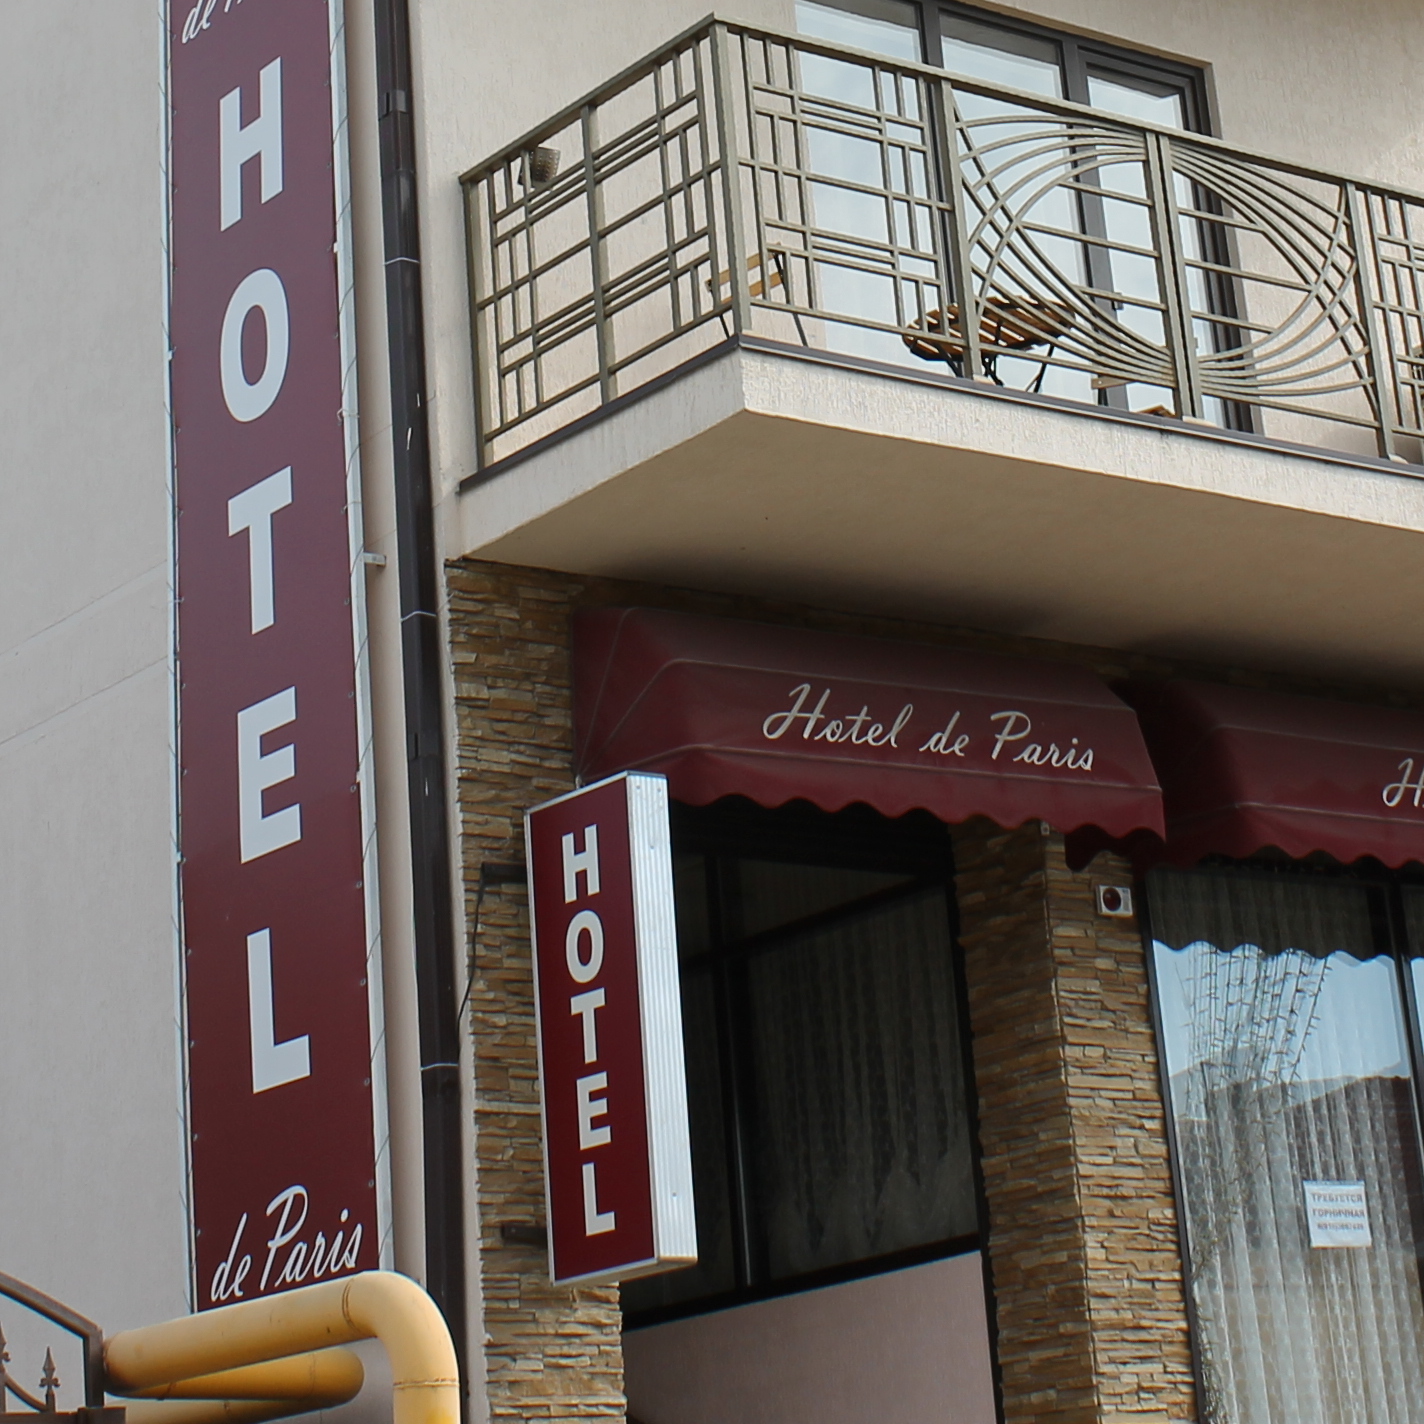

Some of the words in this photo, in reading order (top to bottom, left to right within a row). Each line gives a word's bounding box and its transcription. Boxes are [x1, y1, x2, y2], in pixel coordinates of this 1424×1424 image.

[217, 55, 310, 1095] HOTEL
[762, 682, 914, 749] Hotel
[919, 710, 970, 757] de
[989, 709, 1095, 772] Paris
[560, 822, 617, 1237] HOTEL
[210, 1211, 252, 1302] de
[259, 1184, 364, 1291] Paris
[1311, 1192, 1364, 1204] ТРЕБУЕТСЯ
[1312, 1208, 1366, 1218] ГОРНИЧНАЯ
